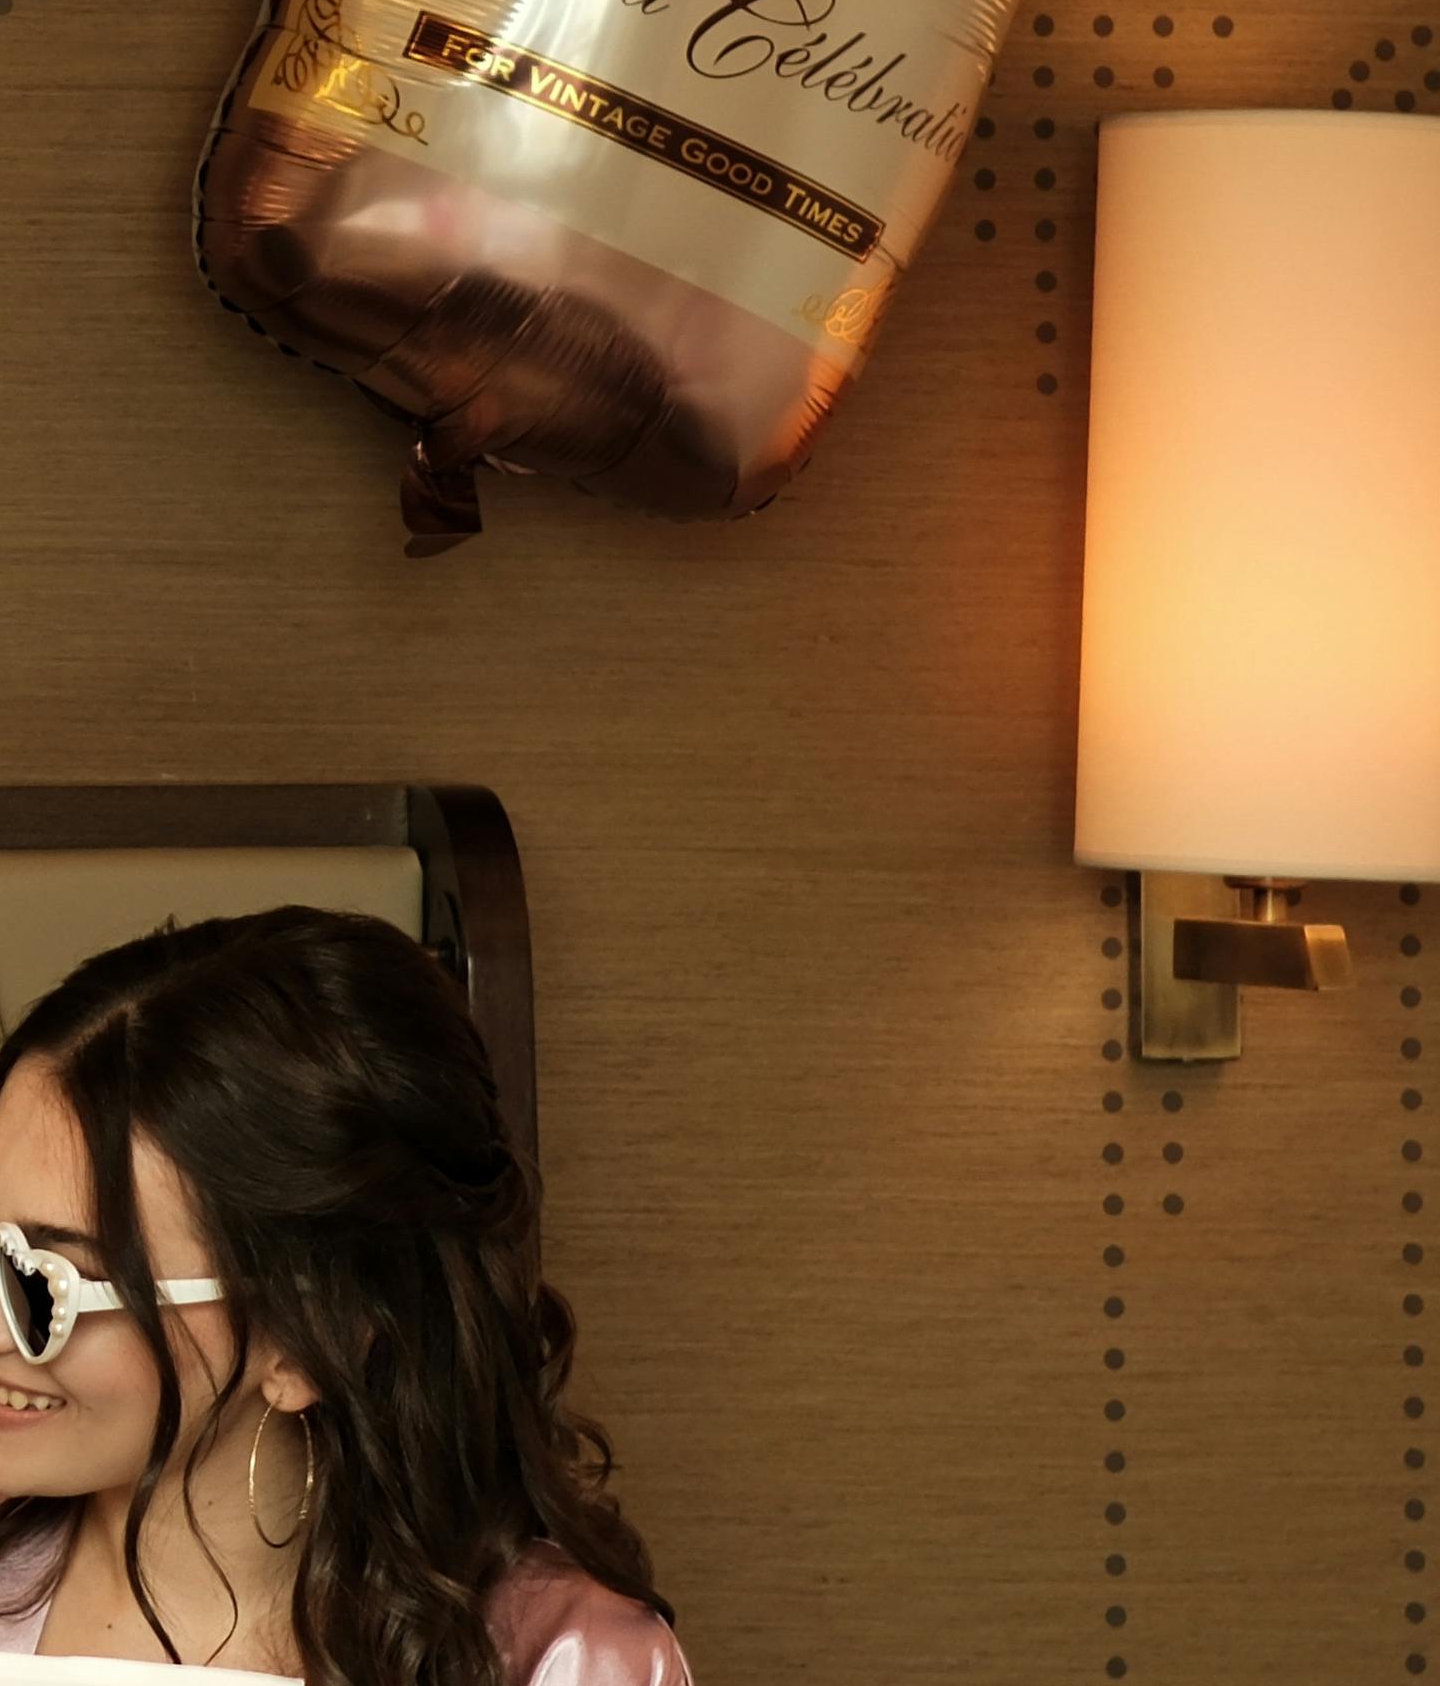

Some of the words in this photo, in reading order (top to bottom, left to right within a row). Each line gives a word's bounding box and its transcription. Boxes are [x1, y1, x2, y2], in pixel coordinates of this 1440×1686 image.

[526, 62, 670, 153] VINTAGE
[678, 135, 780, 203] GOOD
[784, 178, 866, 249] TIMES
